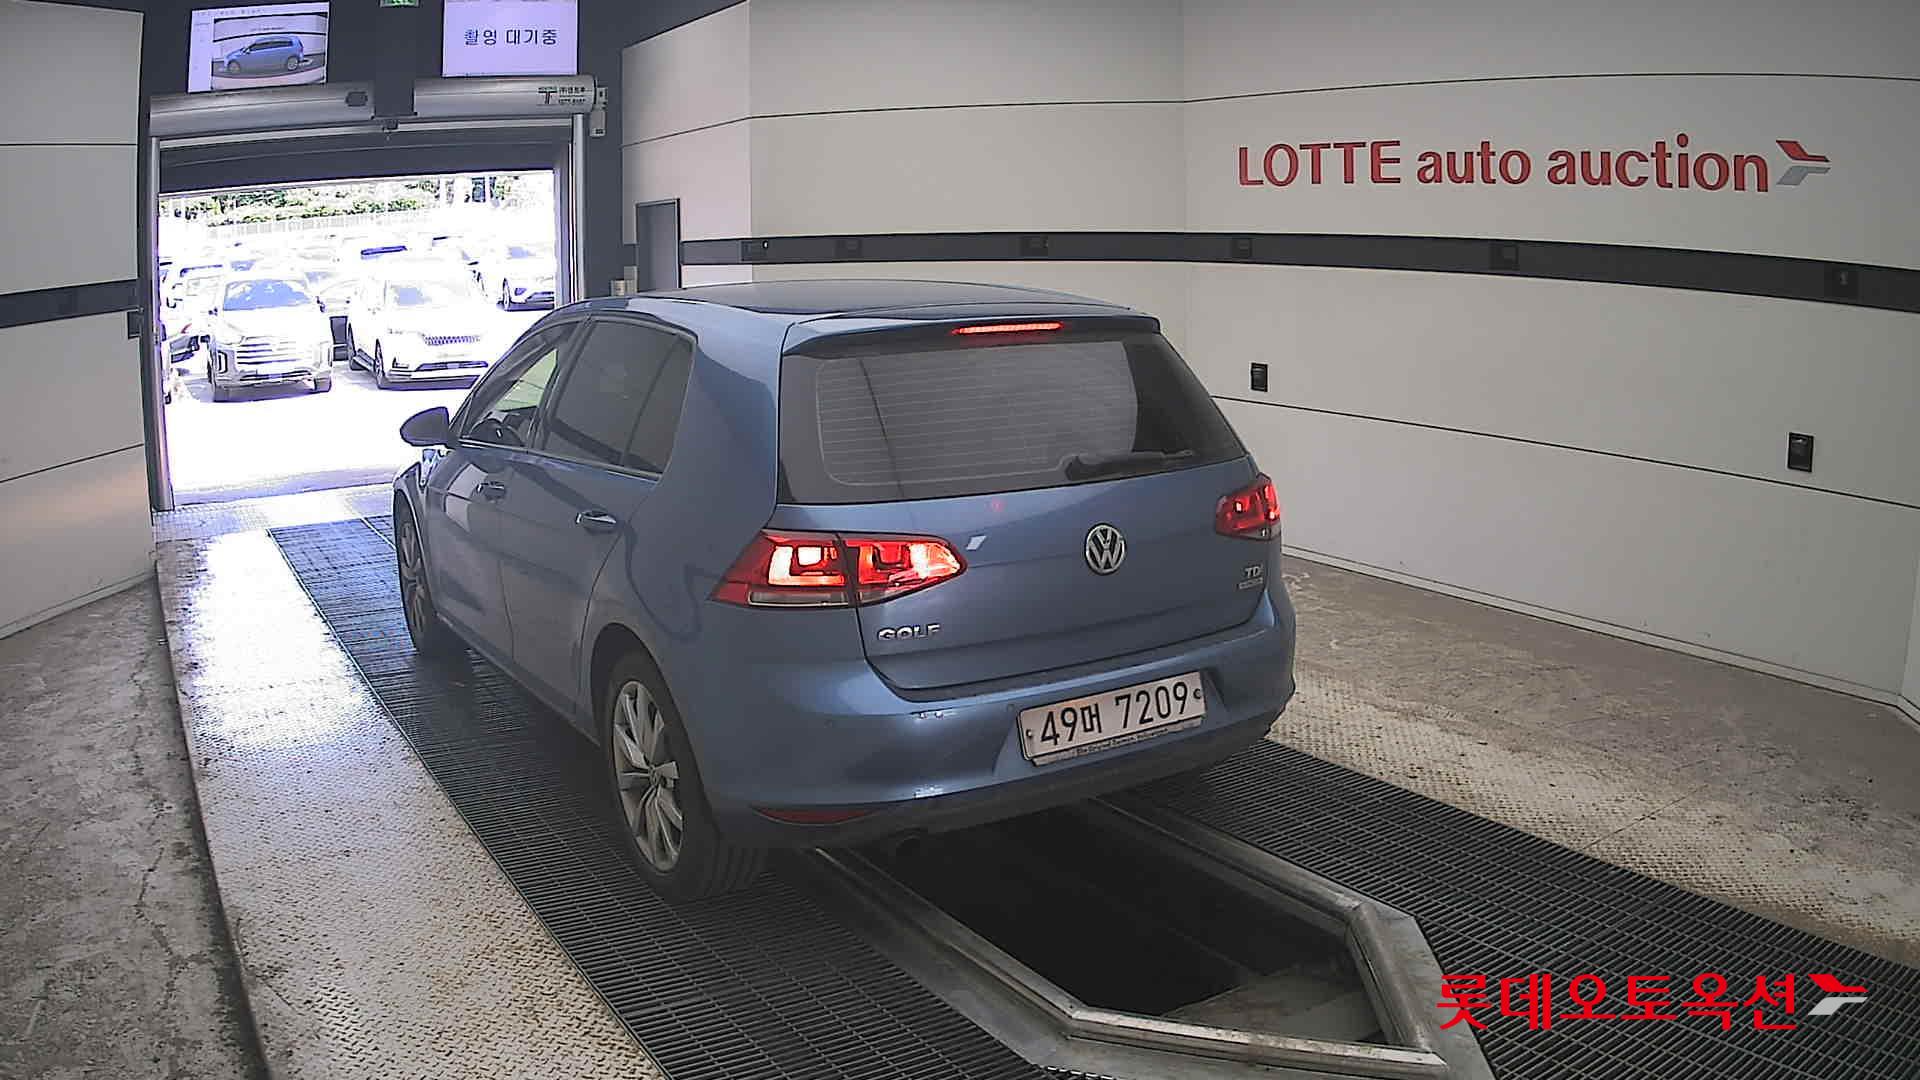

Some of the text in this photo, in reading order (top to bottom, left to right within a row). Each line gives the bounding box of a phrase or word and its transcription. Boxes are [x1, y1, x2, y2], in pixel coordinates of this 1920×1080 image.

[505, 29, 557, 46] 대기중
[1239, 133, 1768, 192] LOTTE auto auction
[877, 623, 941, 641] GOLF
[1041, 703, 1102, 745] 49머
[1115, 682, 1188, 729] 7209
